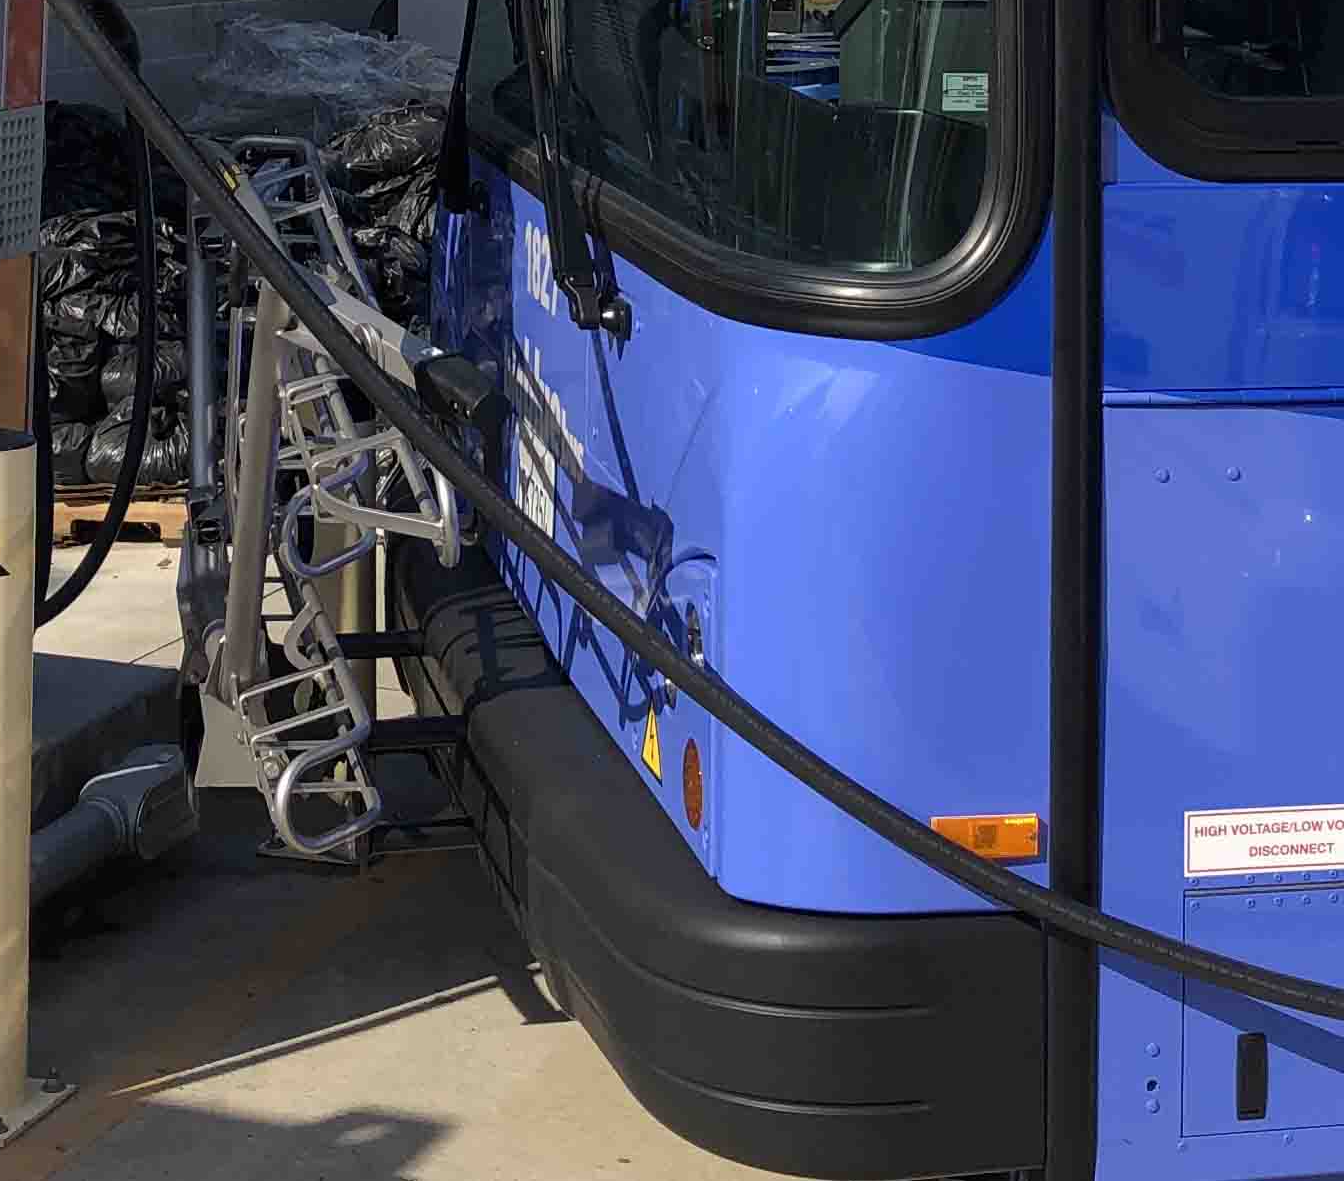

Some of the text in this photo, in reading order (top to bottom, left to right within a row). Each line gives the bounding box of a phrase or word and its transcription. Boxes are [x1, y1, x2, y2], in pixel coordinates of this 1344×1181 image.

[1194, 824, 1228, 838] HIGH
[1231, 820, 1324, 836] VOLTAGE/LOW
[1248, 842, 1336, 858] DISCONNECT
